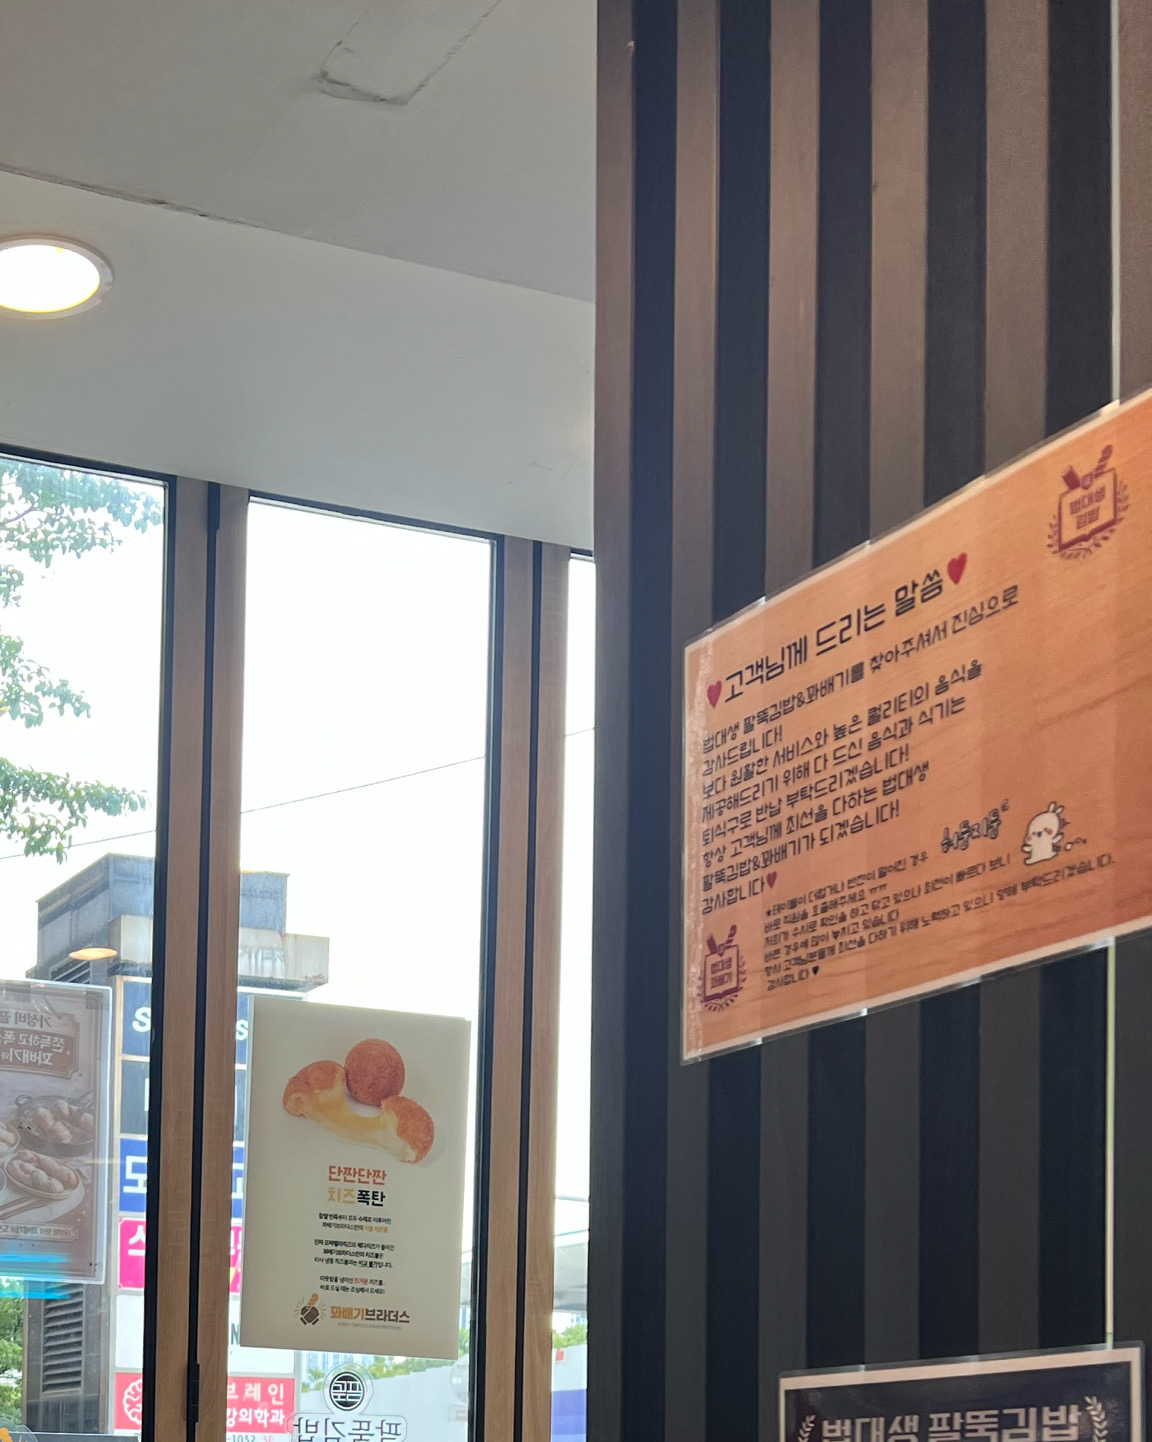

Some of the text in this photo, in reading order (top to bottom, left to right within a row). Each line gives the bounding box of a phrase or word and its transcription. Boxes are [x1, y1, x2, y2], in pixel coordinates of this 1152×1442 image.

[703, 584, 1019, 755] 법대생 팔뚝김밥&꽈배기를 찾아주셔서 진심으로
[725, 569, 944, 703] 고객님께 드리는 말씀
[702, 659, 983, 802] 보다 원활한 서비스와 높은 퀄리티의 음식을
[702, 696, 966, 823] 제공해드리기 위해 다 드신 음식과 식기는
[703, 723, 783, 777] 감사드립니다!
[702, 743, 910, 847] 퇴식구로 반납 부탁드리겠습니다!
[702, 760, 930, 869] 항상 고객님께 최선을 다하는 법대생
[941, 808, 1002, 853] 허둥지둥
[702, 798, 900, 893] 팔뚝김밥&꽈배기가 되겠습니다!
[910, 851, 929, 867] 경우
[702, 876, 766, 916] 감사합니다
[328, 1165, 388, 1186] 단짠단짠
[330, 1305, 411, 1324] 꽈배기브라더스
